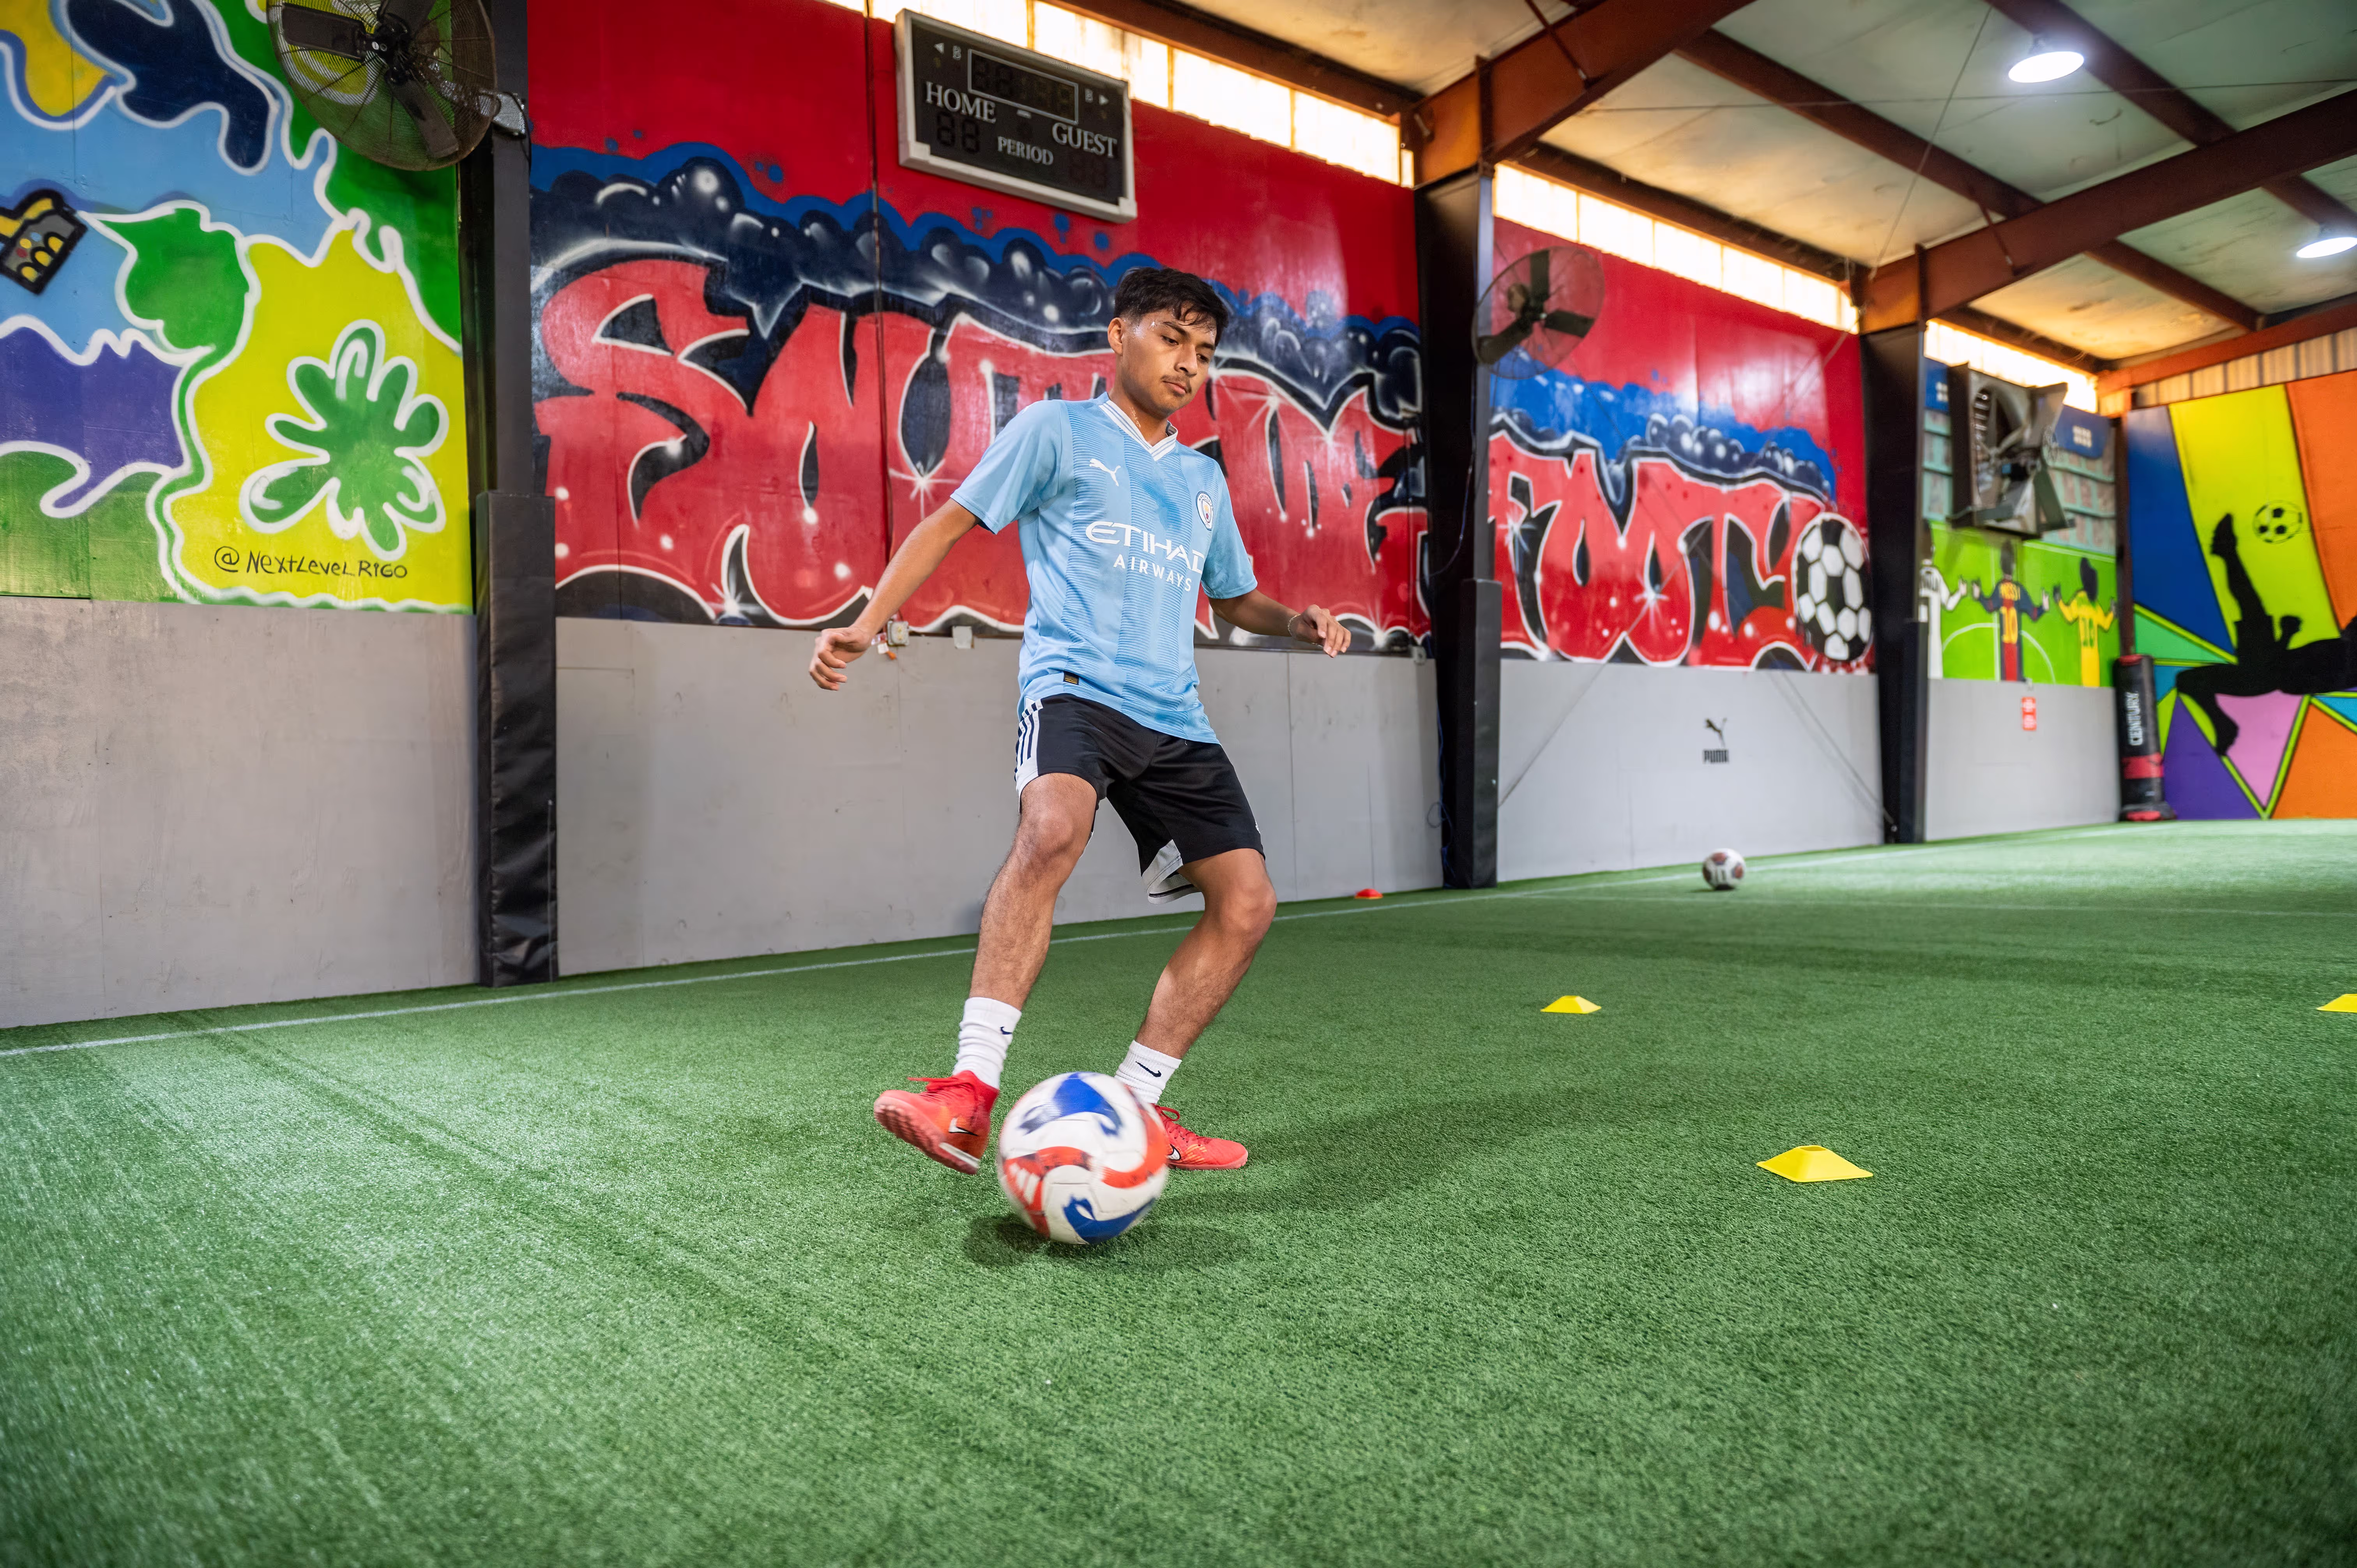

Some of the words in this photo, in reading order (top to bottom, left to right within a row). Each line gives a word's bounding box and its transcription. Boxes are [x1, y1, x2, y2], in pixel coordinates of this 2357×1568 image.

[925, 81, 996, 124] HOME
[997, 136, 1054, 166] PERIOD
[1052, 122, 1118, 158] GUEST
[1085, 520, 1205, 574] ETIHAD
[1113, 553, 1192, 592] AIRWAYS
[2125, 691, 2143, 746] CENTURY
[1703, 749, 1730, 764] PUMA
